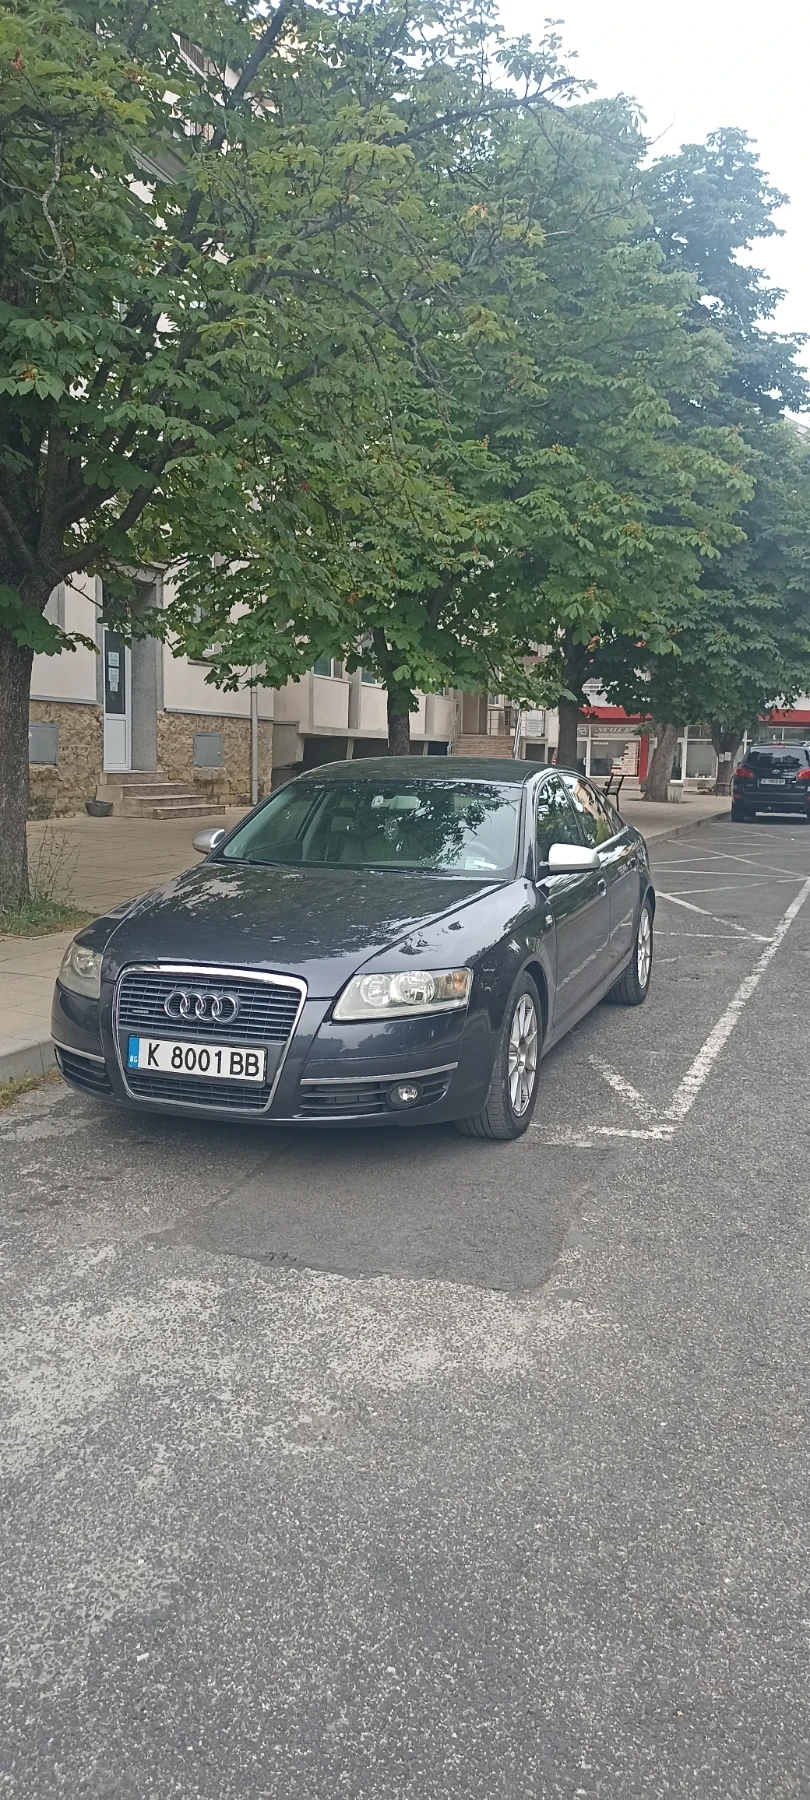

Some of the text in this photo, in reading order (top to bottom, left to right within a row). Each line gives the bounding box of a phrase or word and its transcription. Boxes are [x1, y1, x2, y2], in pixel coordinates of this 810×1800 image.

[129, 1055, 138, 1063] BG
[147, 1043, 260, 1077] K 8001 BB
